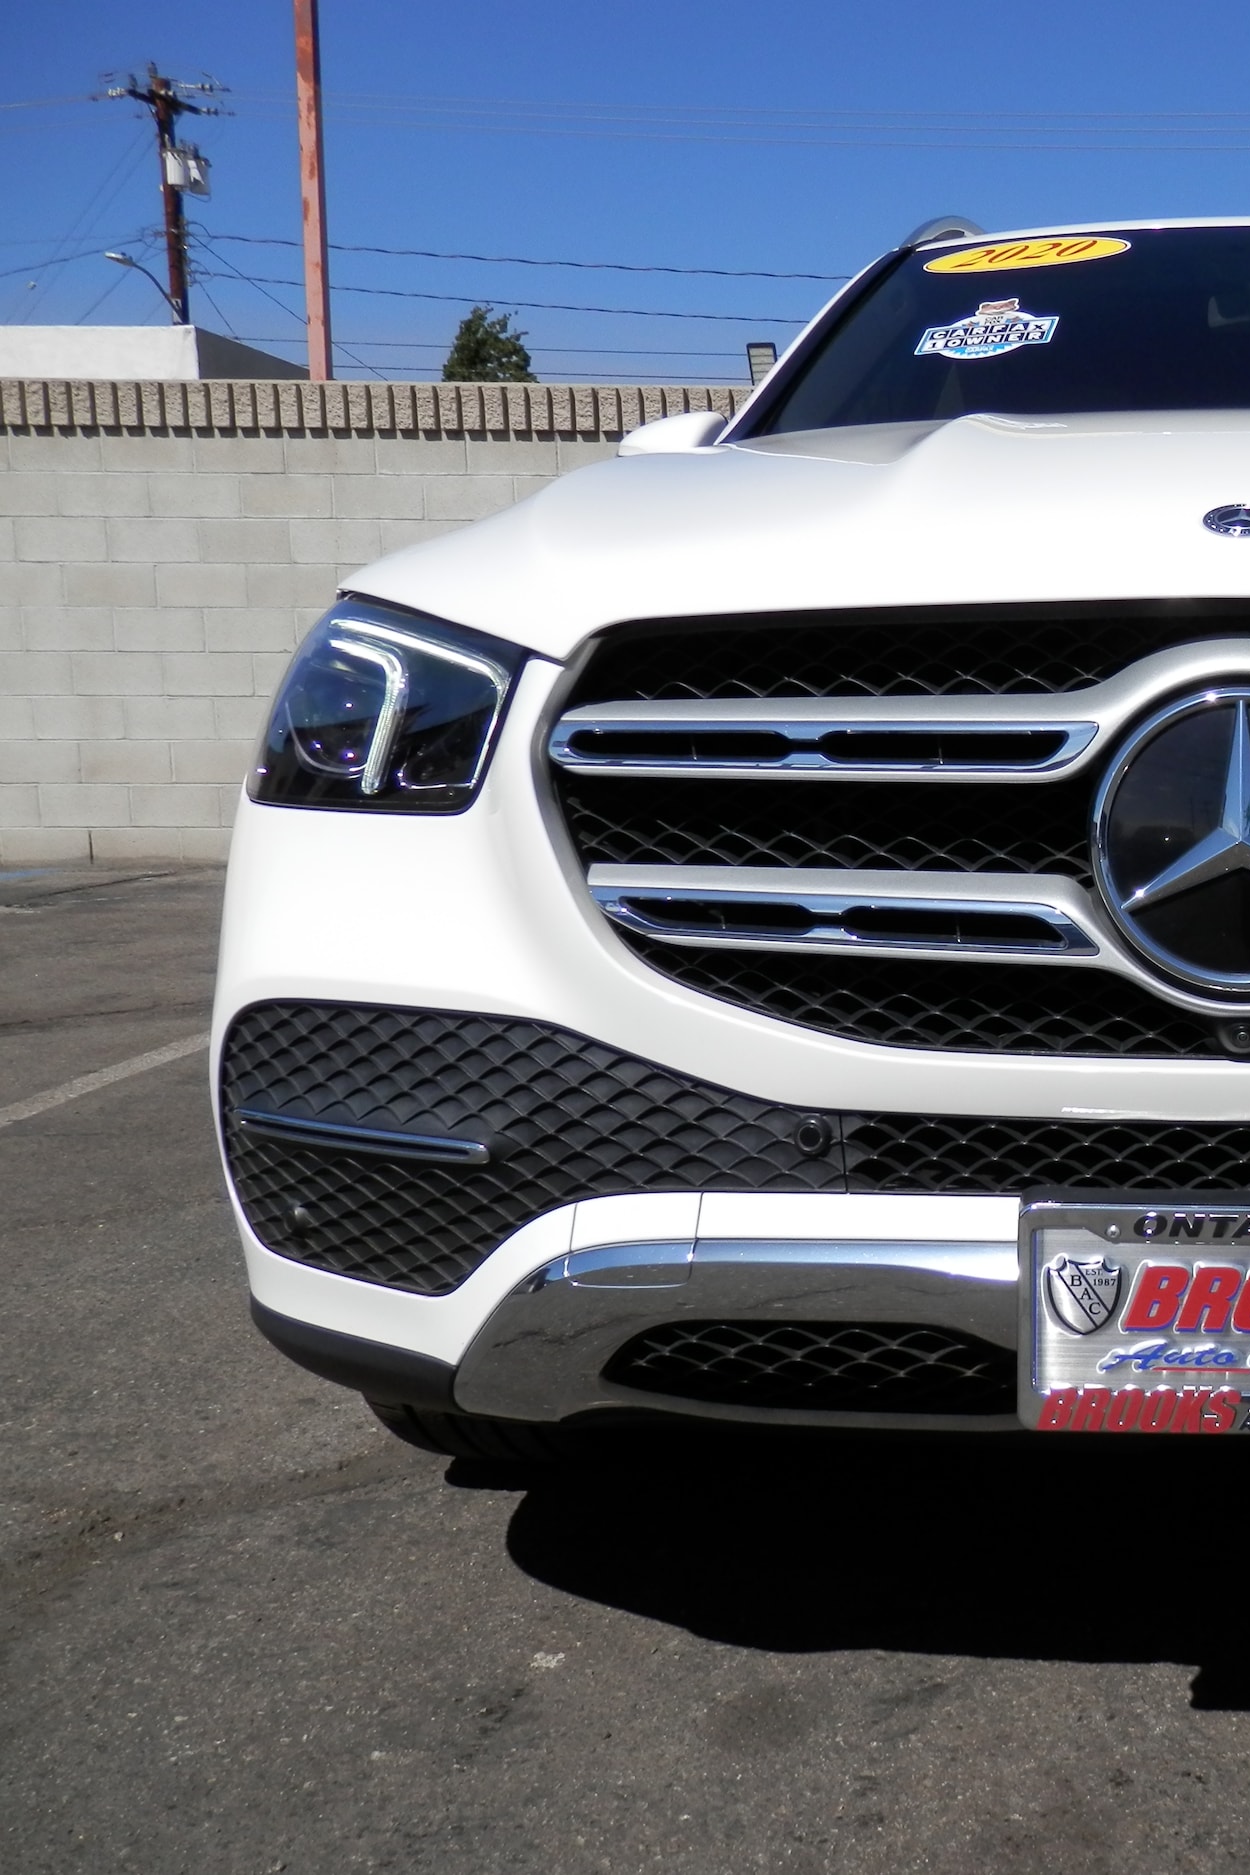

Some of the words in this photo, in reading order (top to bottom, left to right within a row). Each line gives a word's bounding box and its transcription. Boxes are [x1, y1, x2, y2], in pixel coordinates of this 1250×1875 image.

[949, 239, 1098, 269] 2020
[932, 323, 1047, 340] CARFAX
[947, 332, 1042, 348] OWNER
[1093, 1278, 1116, 1287] 1987
[1102, 1342, 1238, 1372] Auto
[1036, 1385, 1241, 1434] BROOKS
